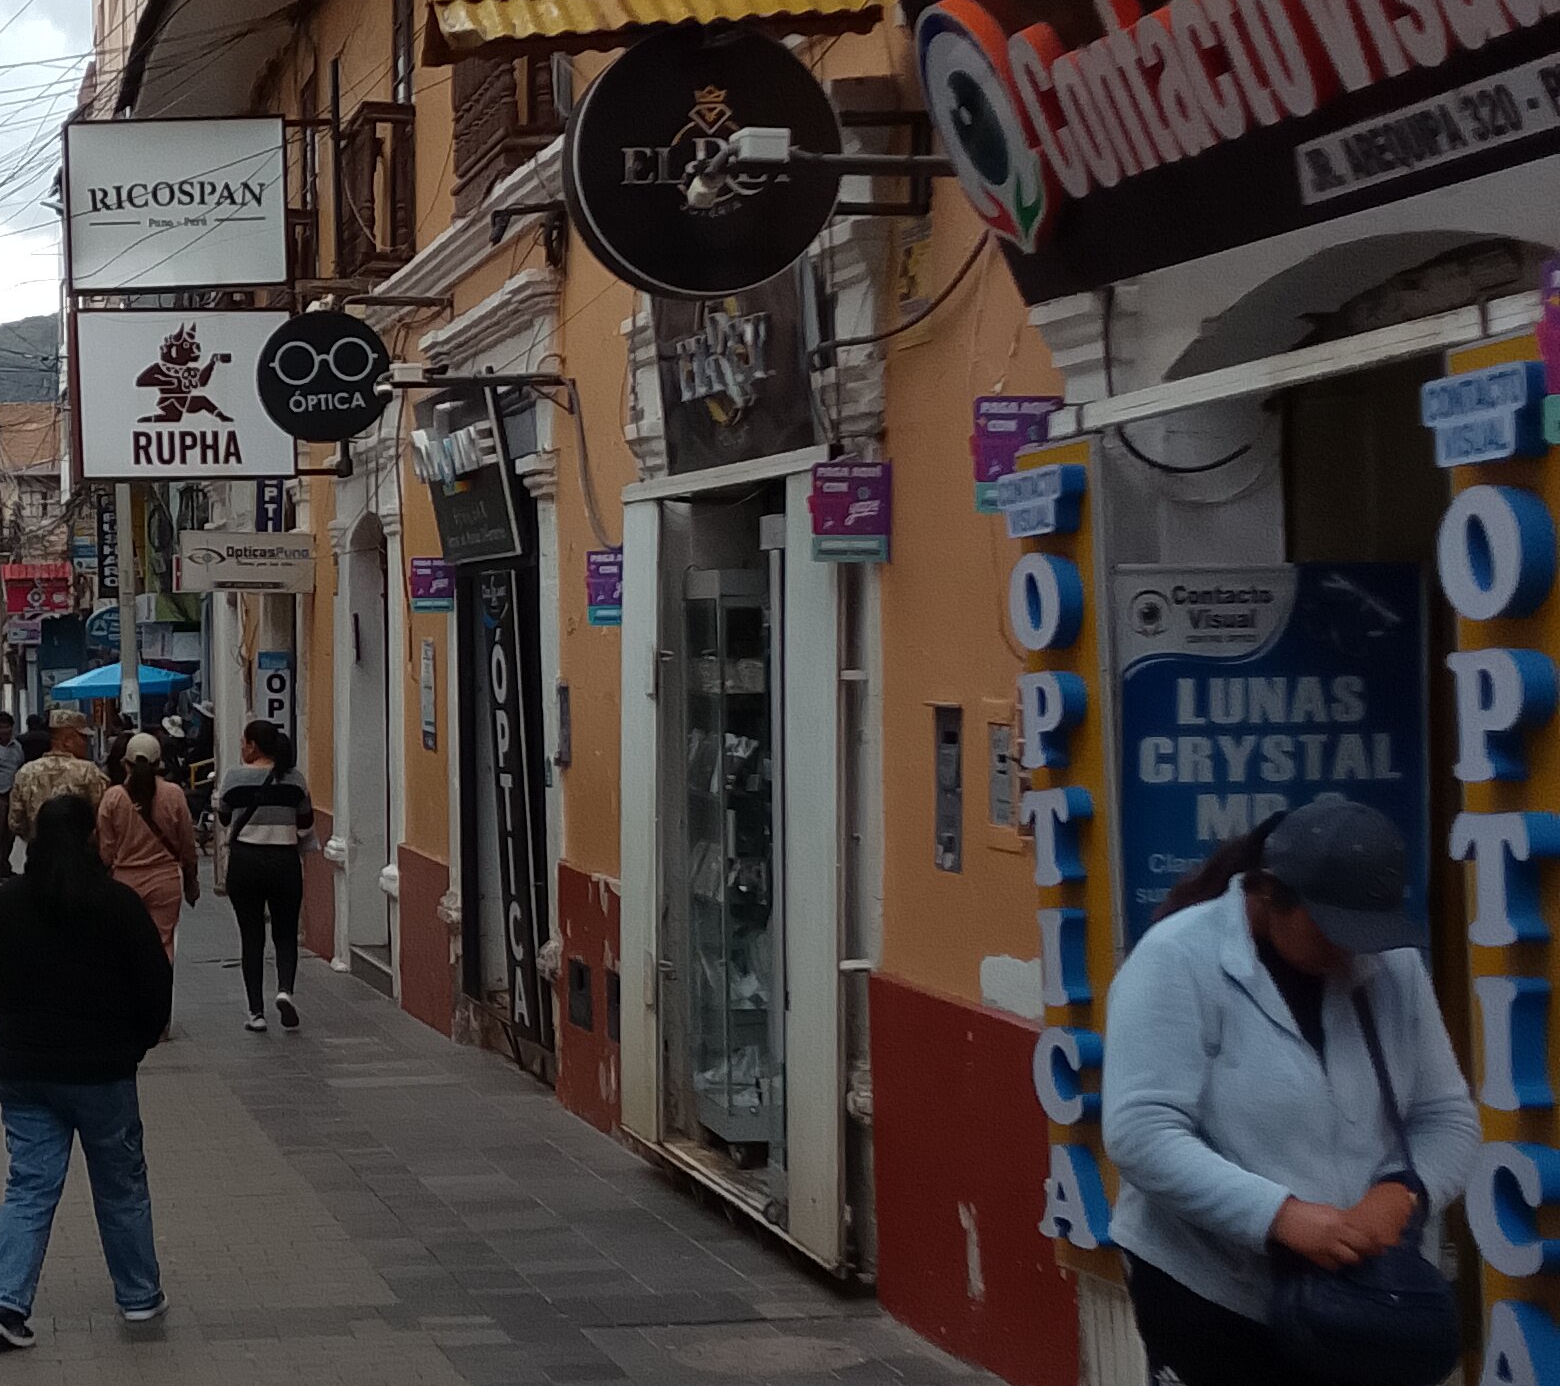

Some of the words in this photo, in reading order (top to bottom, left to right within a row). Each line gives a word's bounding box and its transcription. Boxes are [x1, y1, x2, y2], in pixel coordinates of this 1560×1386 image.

[87, 180, 266, 213] RICOSPAN
[148, 217, 174, 228] Puno
[288, 388, 366, 413] ÓPTICA
[132, 429, 243, 465] RUPHA
[1172, 586, 1274, 605] Contacto
[1188, 609, 1258, 629] Visual
[1175, 676, 1367, 725] LUNAS
[1139, 733, 1403, 784] CRYSTAL
[490, 625, 532, 1029] ÓPTICA
[1007, 552, 1118, 1251] OPTICA
